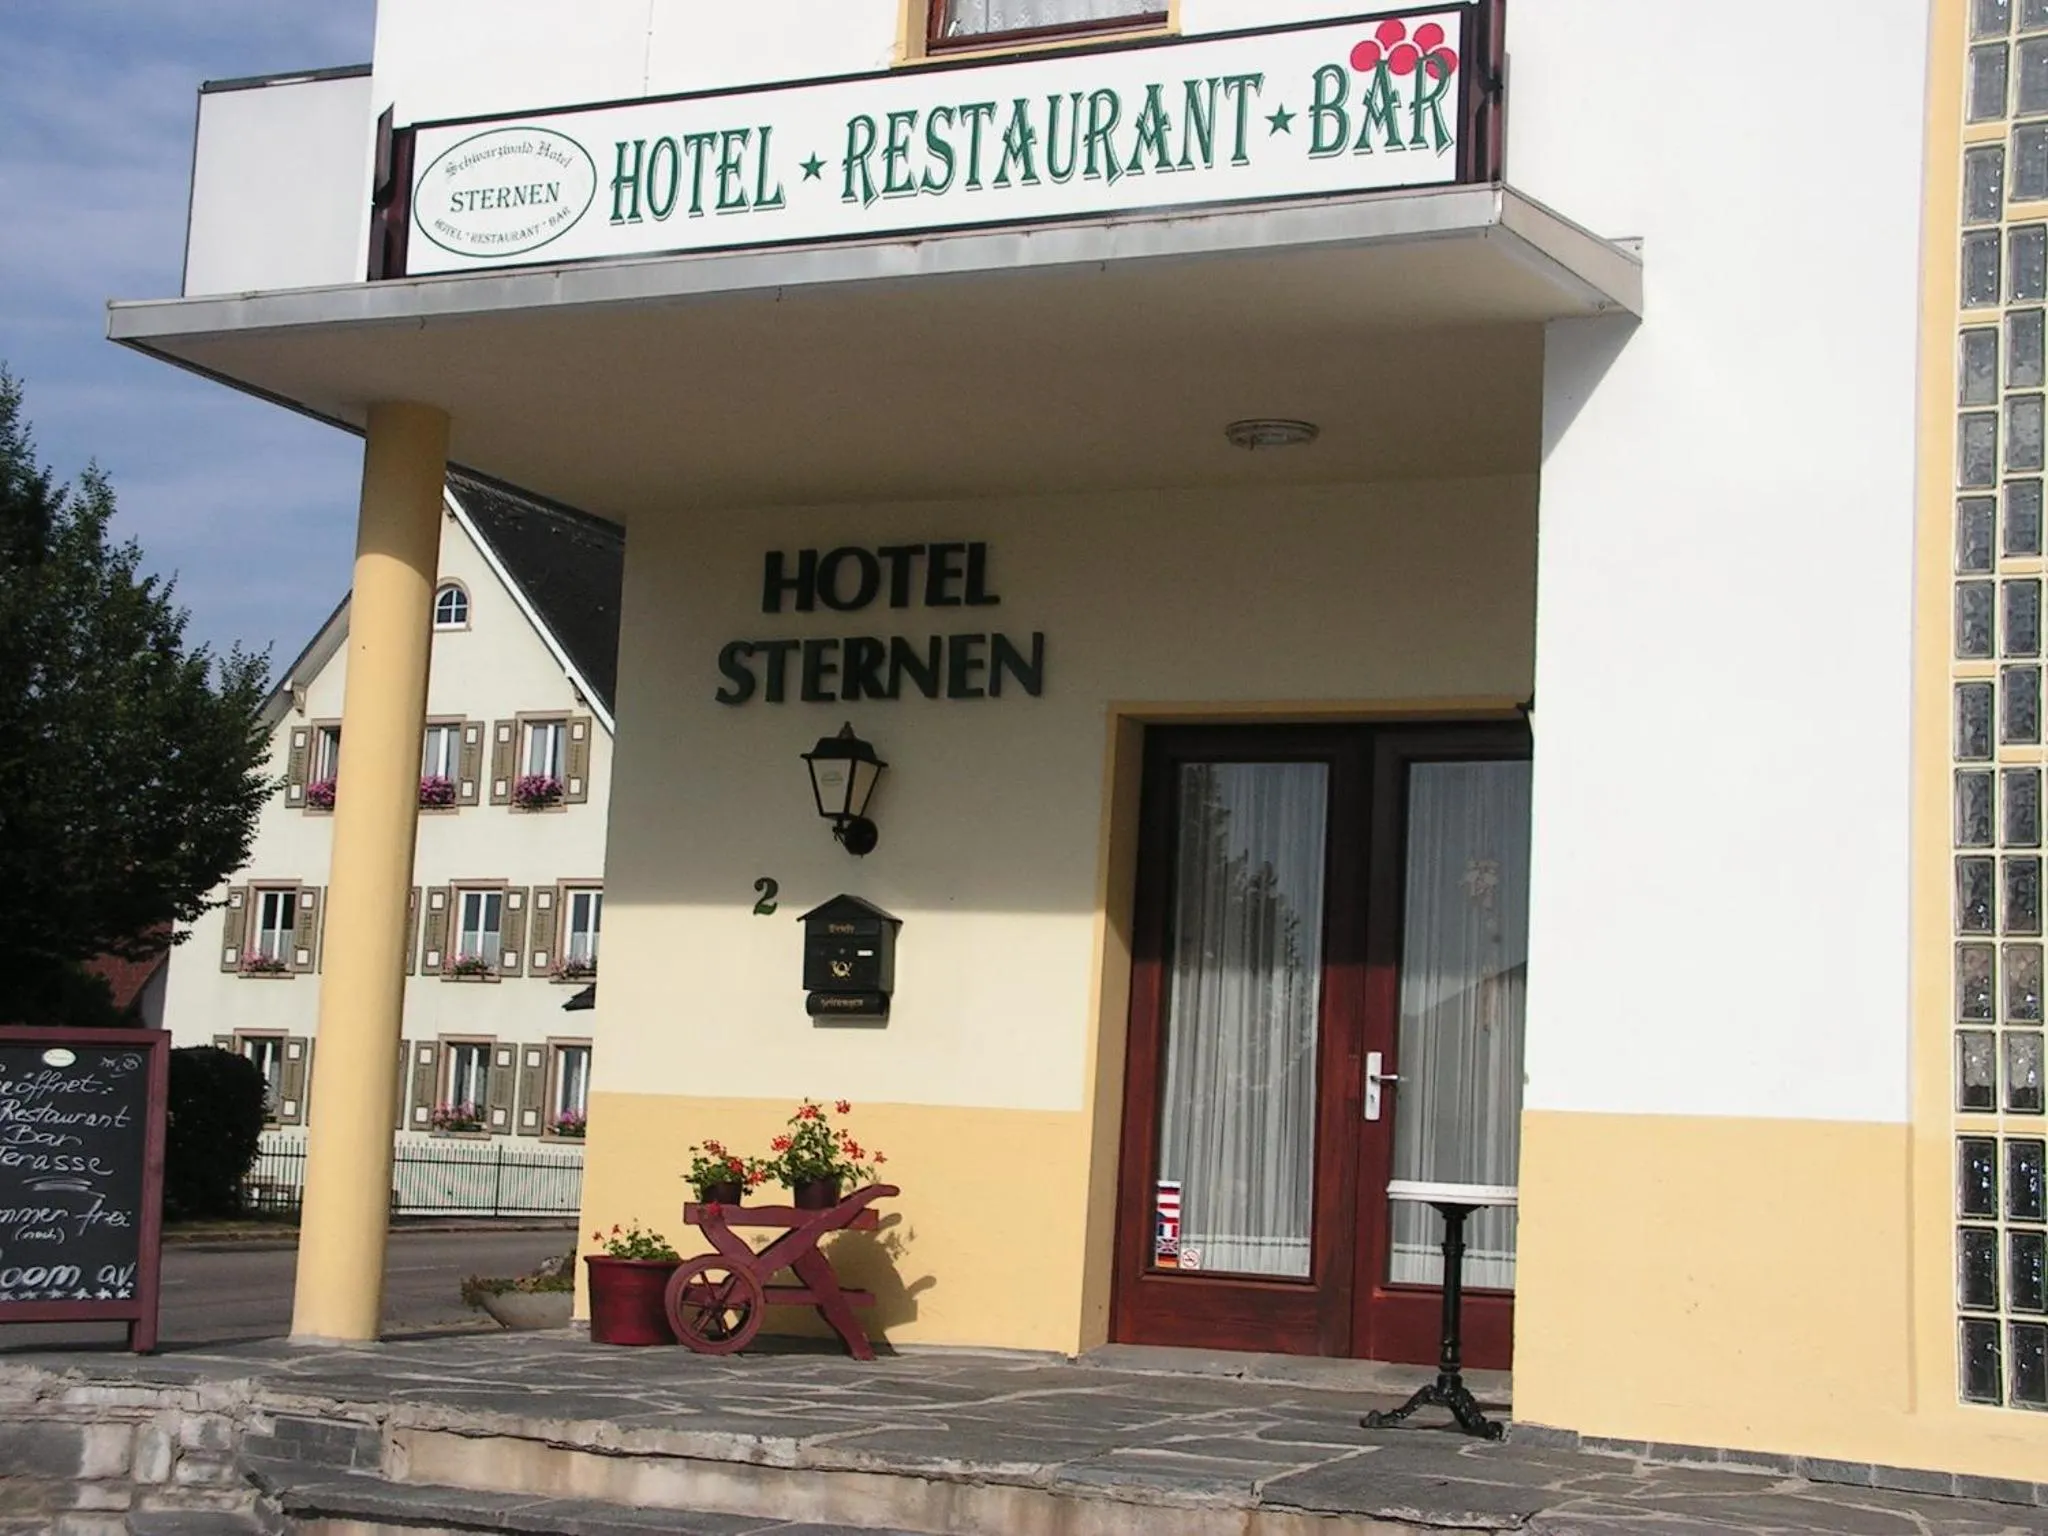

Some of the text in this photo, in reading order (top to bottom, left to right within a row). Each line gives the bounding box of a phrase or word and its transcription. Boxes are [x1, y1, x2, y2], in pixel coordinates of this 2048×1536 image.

[537, 140, 573, 169] Hotel
[609, 53, 1455, 226] HOTEL RESTAURANT BAR
[450, 181, 561, 214] STERNEN
[434, 205, 572, 245] HOTEL RESTAURANT BAR
[762, 542, 1001, 613] HOTEL
[715, 631, 1045, 706] STERNEN
[753, 877, 779, 915] 2
[0, 1069, 114, 1104] eöffnet:
[0, 1099, 131, 1128] Restaurant
[3, 1123, 83, 1146] Bar
[76, 1193, 132, 1236] frei
[0, 1263, 82, 1288] oom
